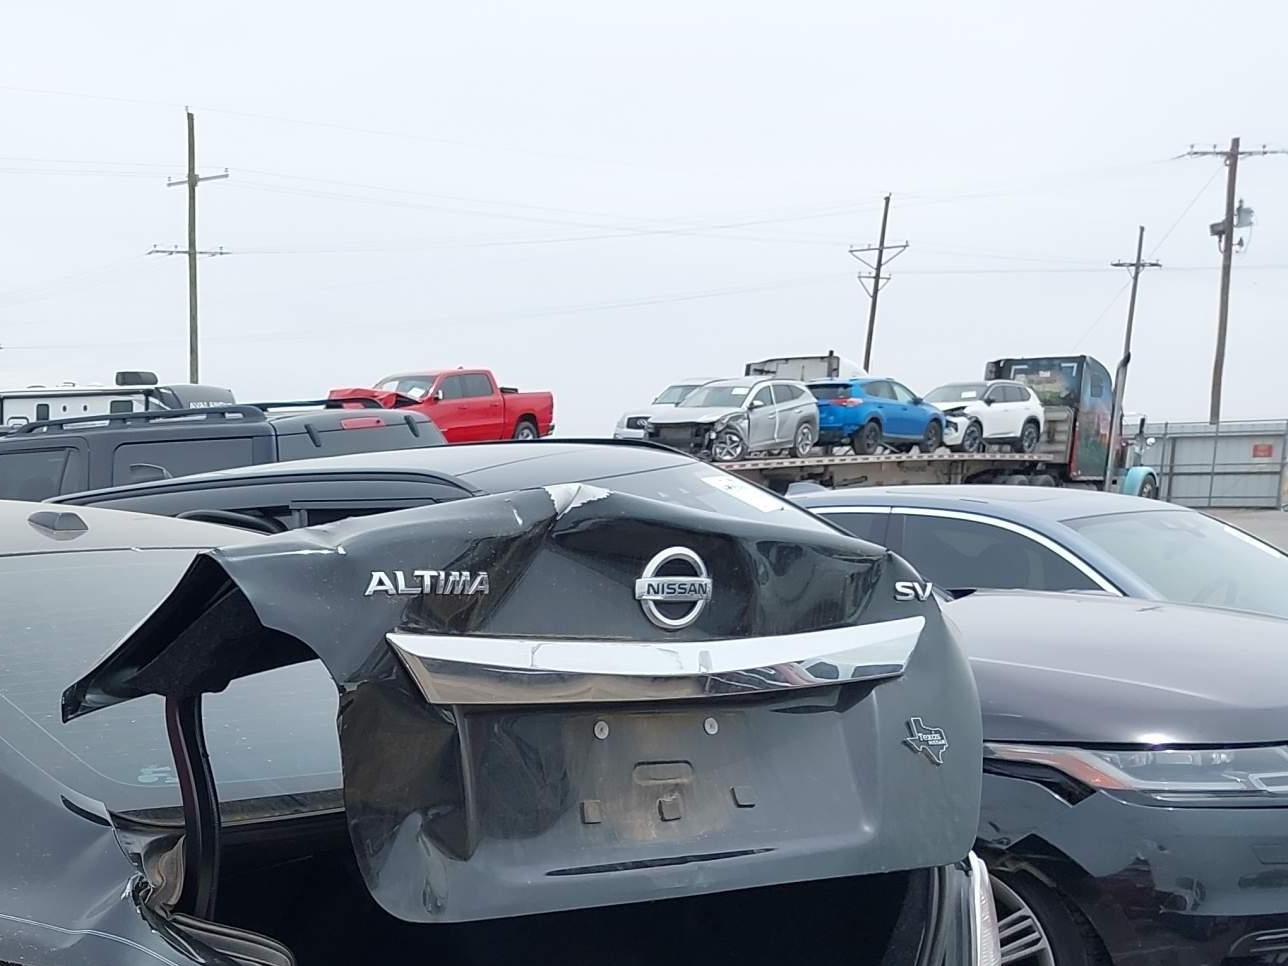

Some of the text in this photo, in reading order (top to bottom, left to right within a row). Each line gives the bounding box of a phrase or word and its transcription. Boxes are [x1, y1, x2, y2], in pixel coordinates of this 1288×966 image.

[364, 570, 490, 596] ALTIMA
[646, 582, 708, 595] NISSAN
[895, 581, 933, 601] SV
